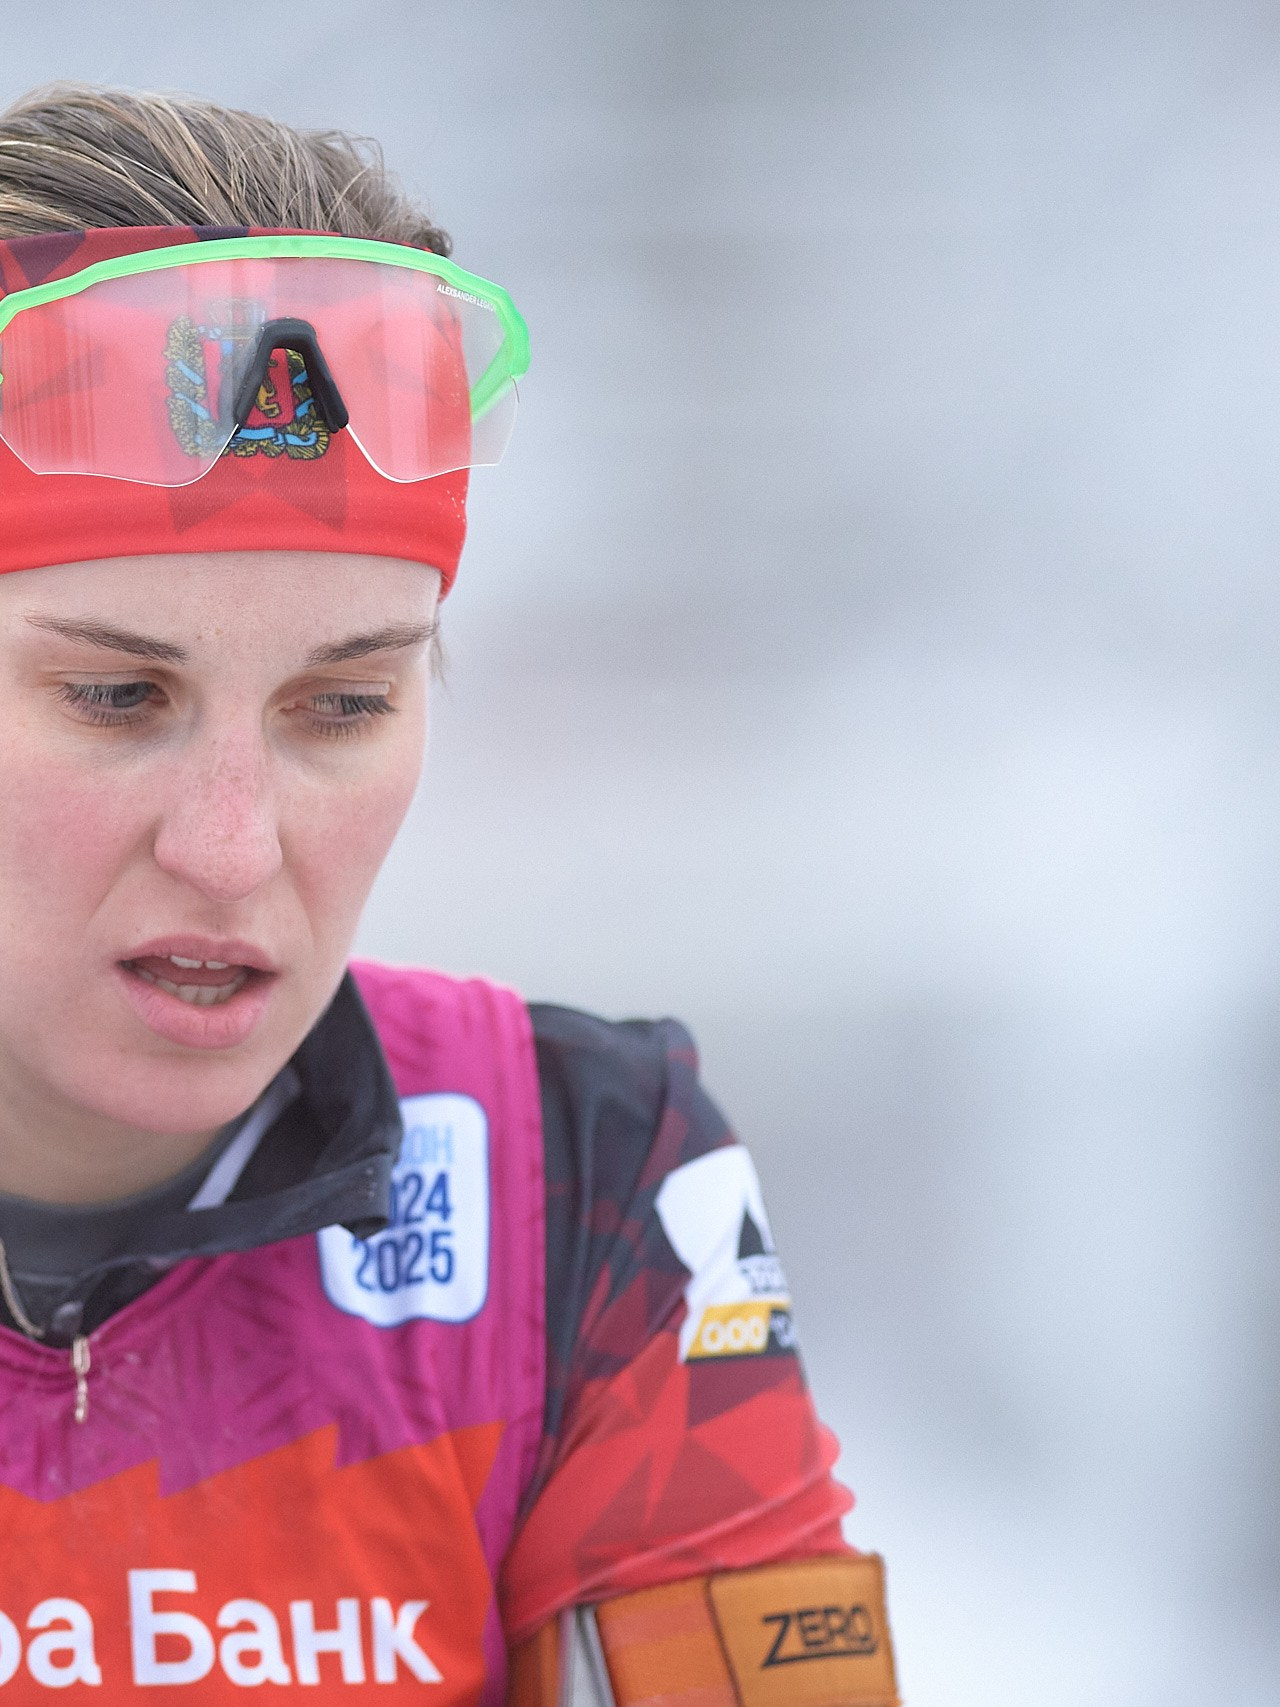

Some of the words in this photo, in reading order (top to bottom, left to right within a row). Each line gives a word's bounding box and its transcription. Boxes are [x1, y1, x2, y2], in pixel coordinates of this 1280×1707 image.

[352, 1230, 454, 1294] 2025
[128, 1568, 444, 1688] Банк
[760, 1604, 878, 1669] ZERO
